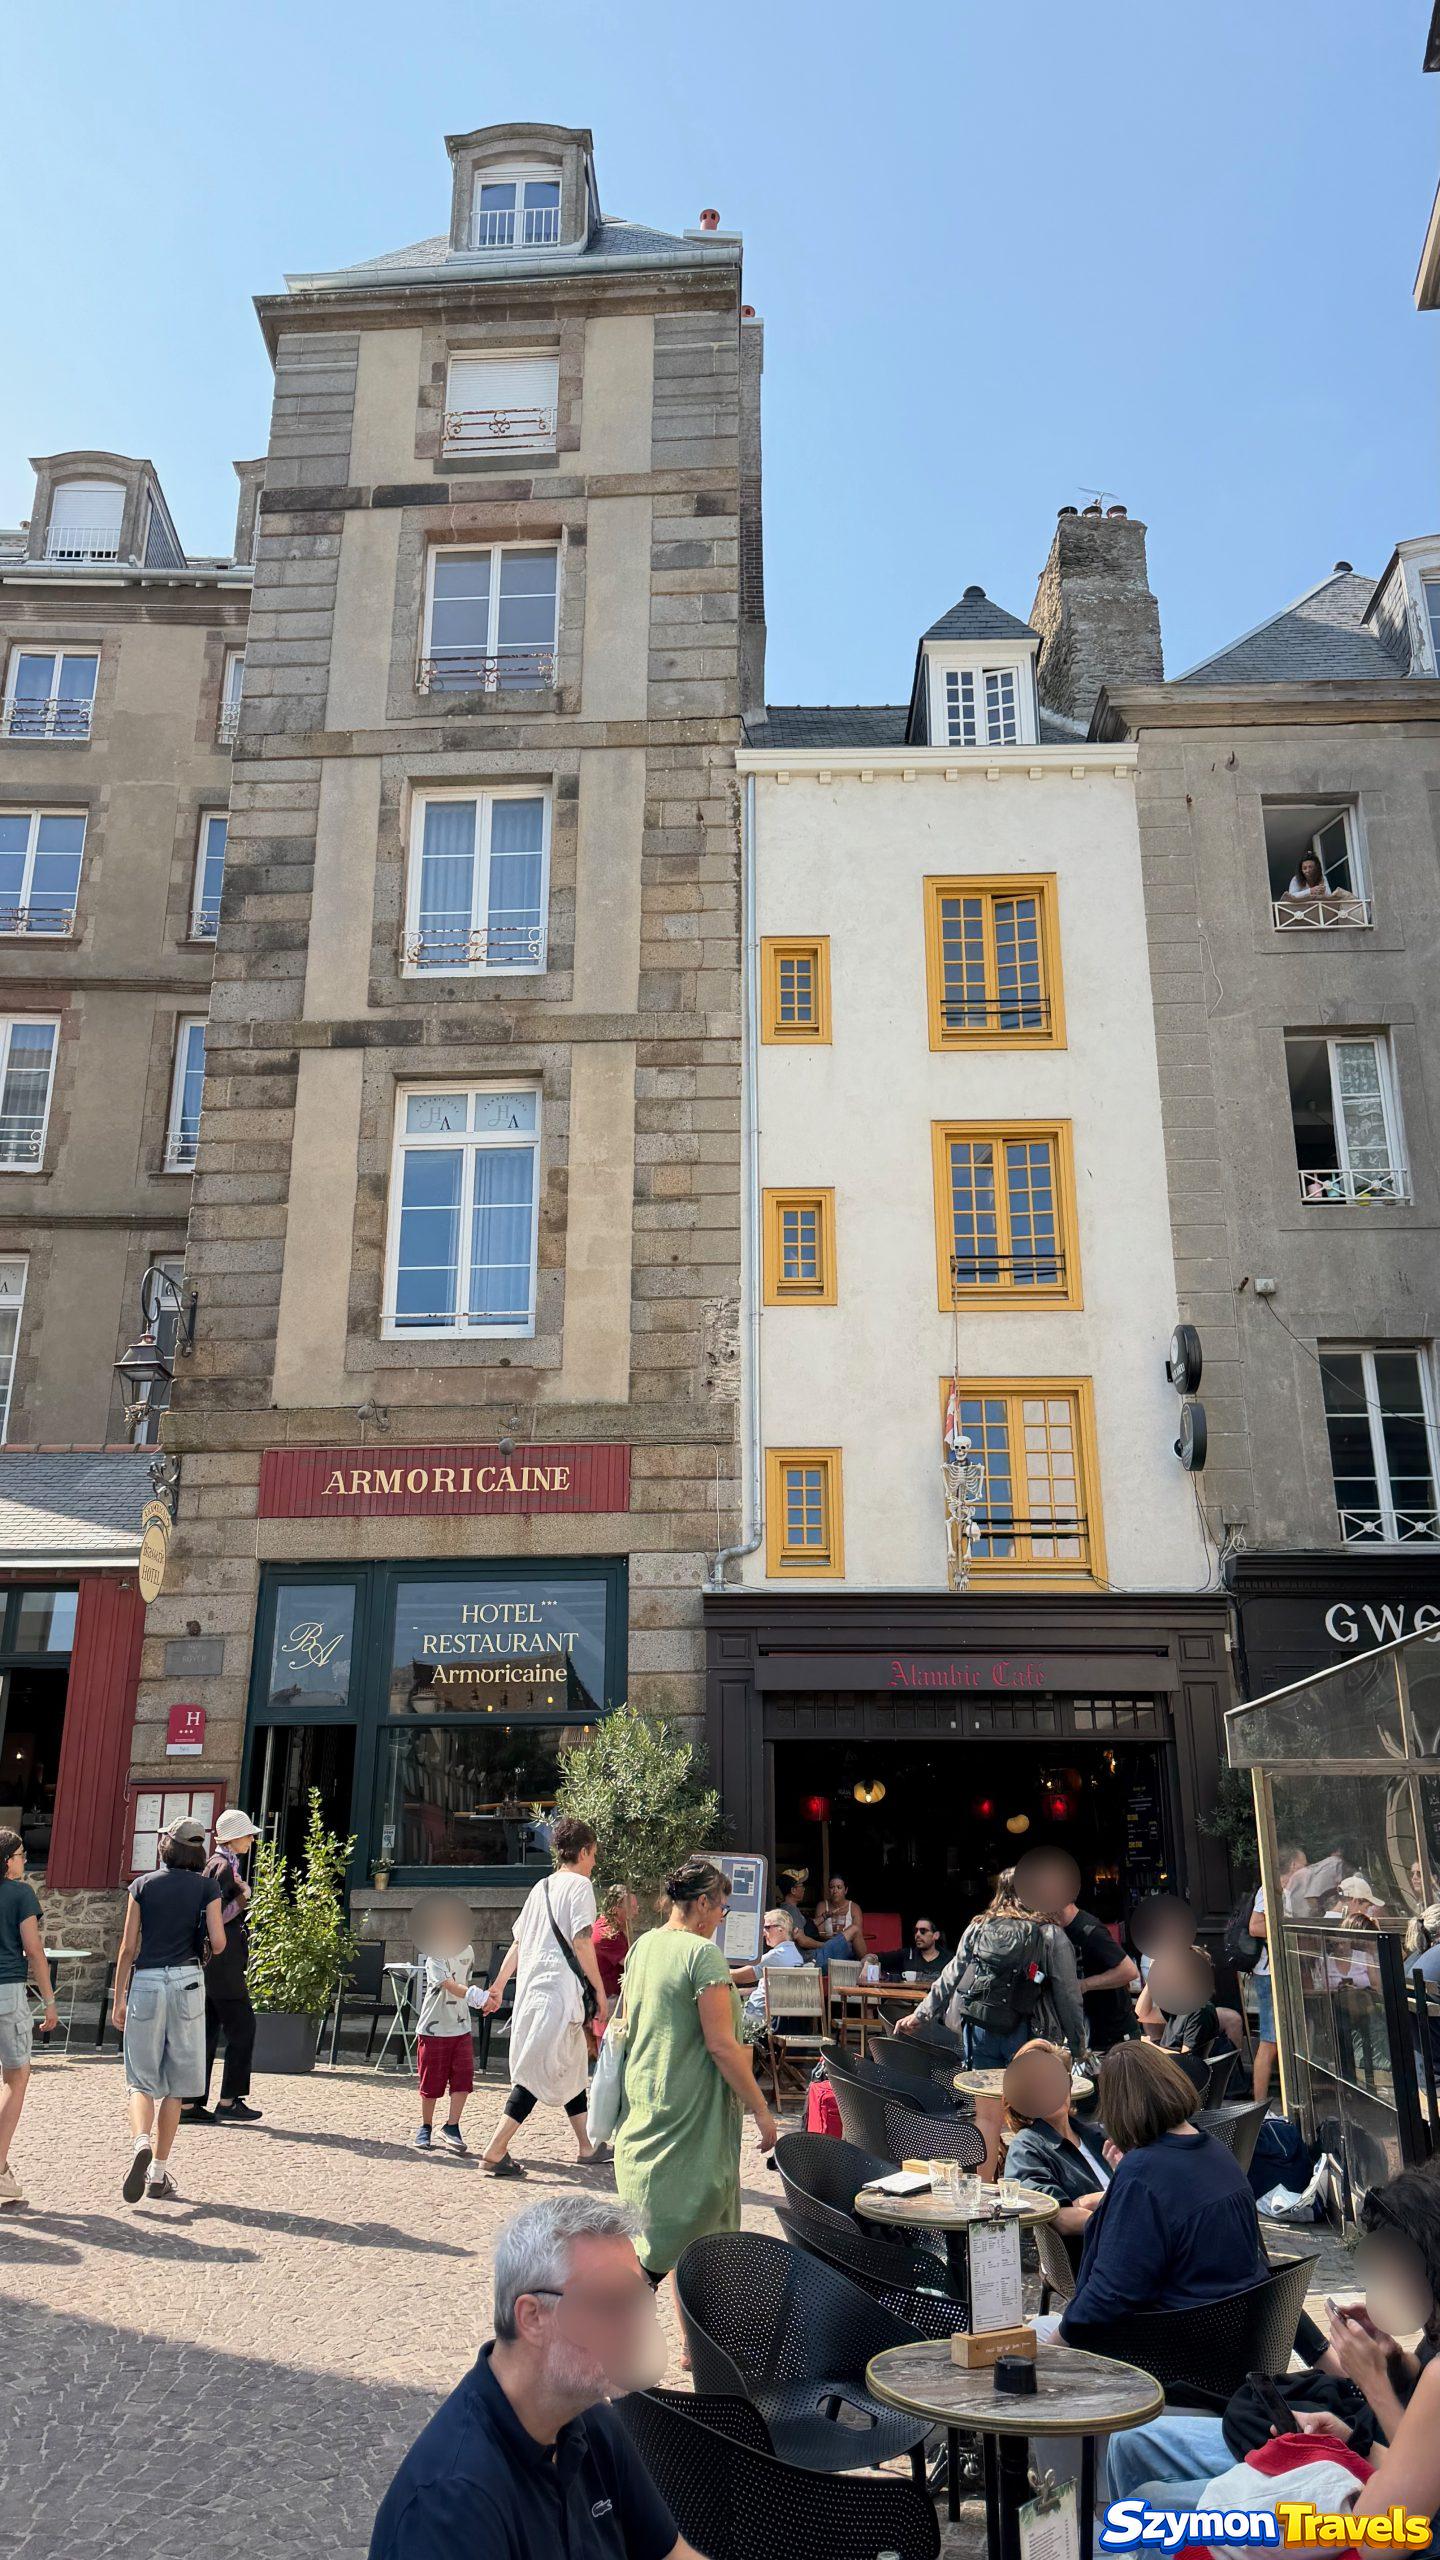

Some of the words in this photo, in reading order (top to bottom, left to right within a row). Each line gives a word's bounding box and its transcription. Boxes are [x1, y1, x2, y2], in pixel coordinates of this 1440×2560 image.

[321, 1467, 571, 1495] ARMORICAINE
[141, 1564, 160, 1586] HOTEL
[461, 1603, 543, 1624] HOTEL
[422, 1632, 579, 1654] RESTAURANT
[430, 1663, 568, 1684] Armoricaine
[887, 1660, 982, 1688] Alambic
[186, 1711, 201, 1726] H
